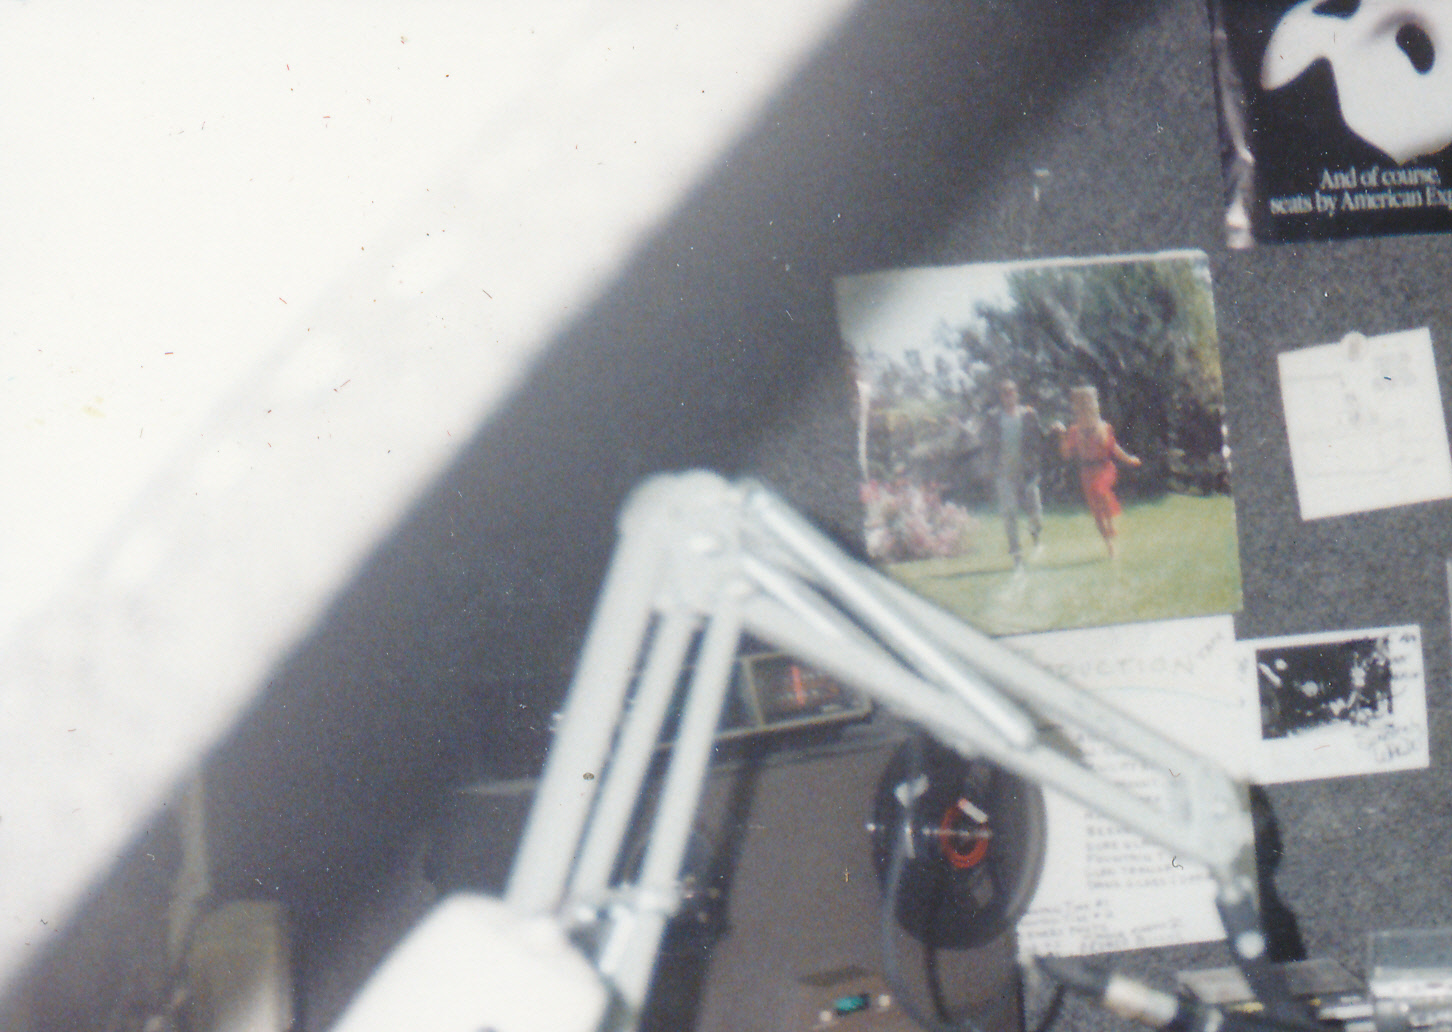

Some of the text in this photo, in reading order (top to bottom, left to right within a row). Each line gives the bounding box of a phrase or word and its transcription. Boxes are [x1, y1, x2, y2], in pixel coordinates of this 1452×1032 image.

[1320, 166, 1357, 190] And
[1360, 164, 1379, 187] of
[1270, 196, 1313, 215] seats
[1314, 189, 1337, 217] by
[1341, 187, 1423, 211] American
